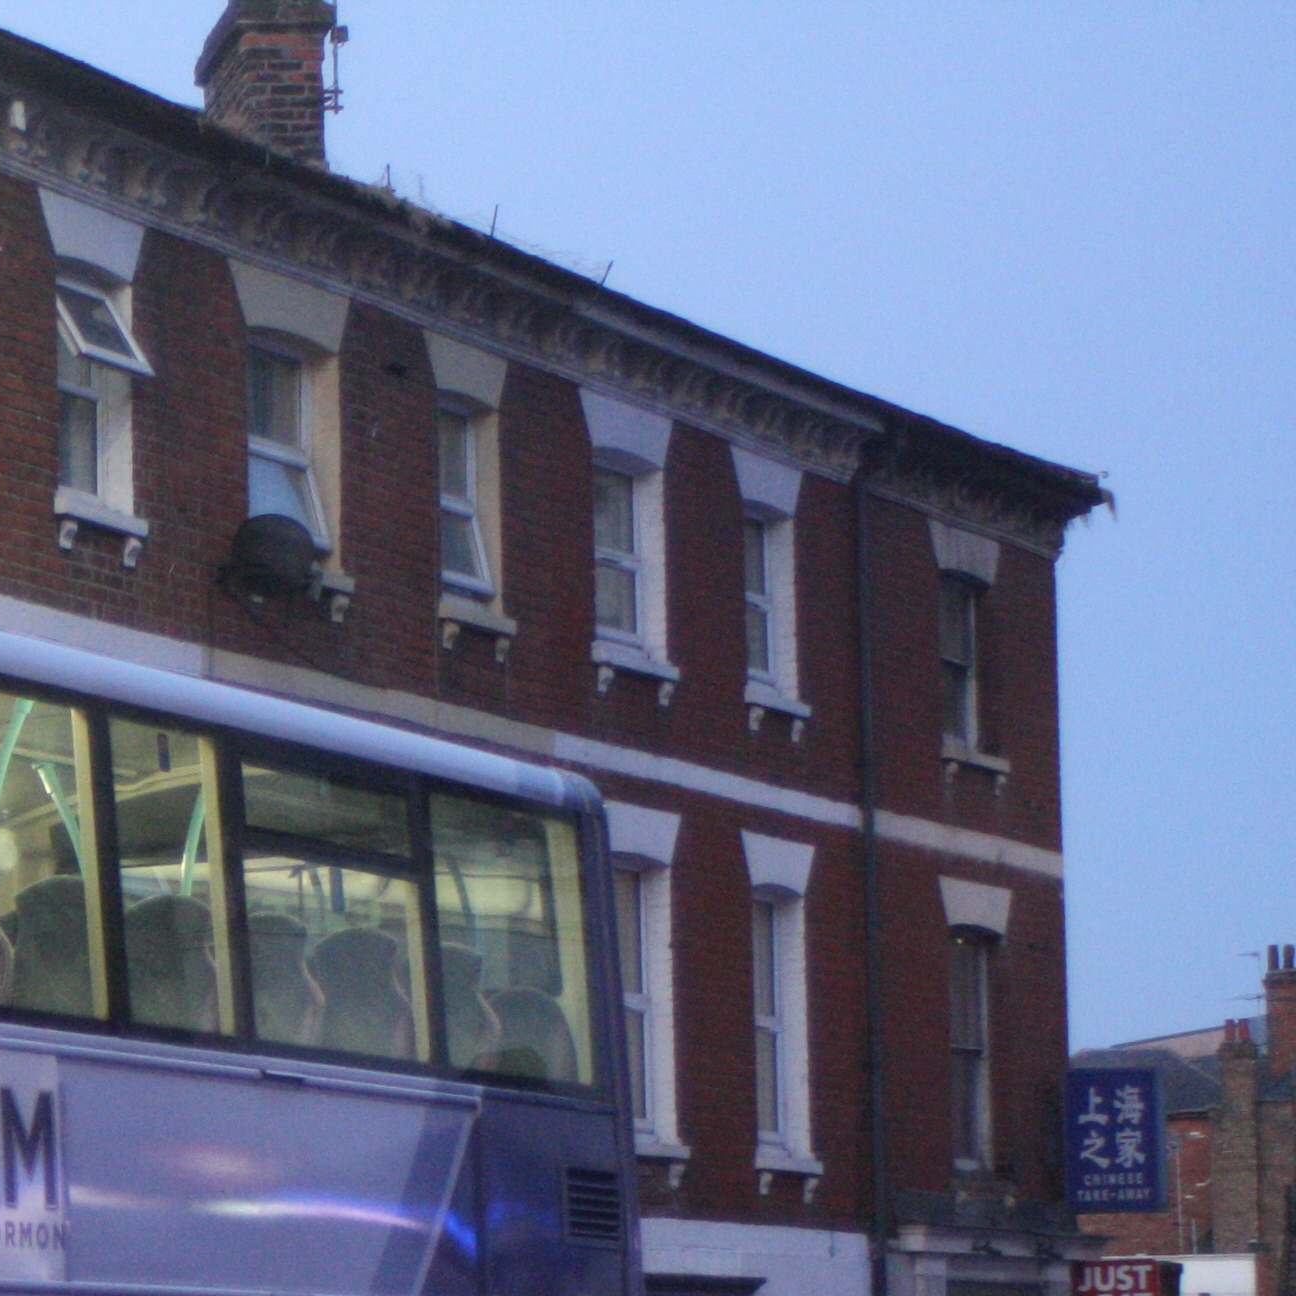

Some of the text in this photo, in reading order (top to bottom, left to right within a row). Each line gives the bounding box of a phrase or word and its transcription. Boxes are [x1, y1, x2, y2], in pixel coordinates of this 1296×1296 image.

[1083, 1172, 1144, 1187] CHINESE
[1077, 1187, 1150, 1202] TAKE-AWAY
[1078, 1265, 1153, 1292] JUST
